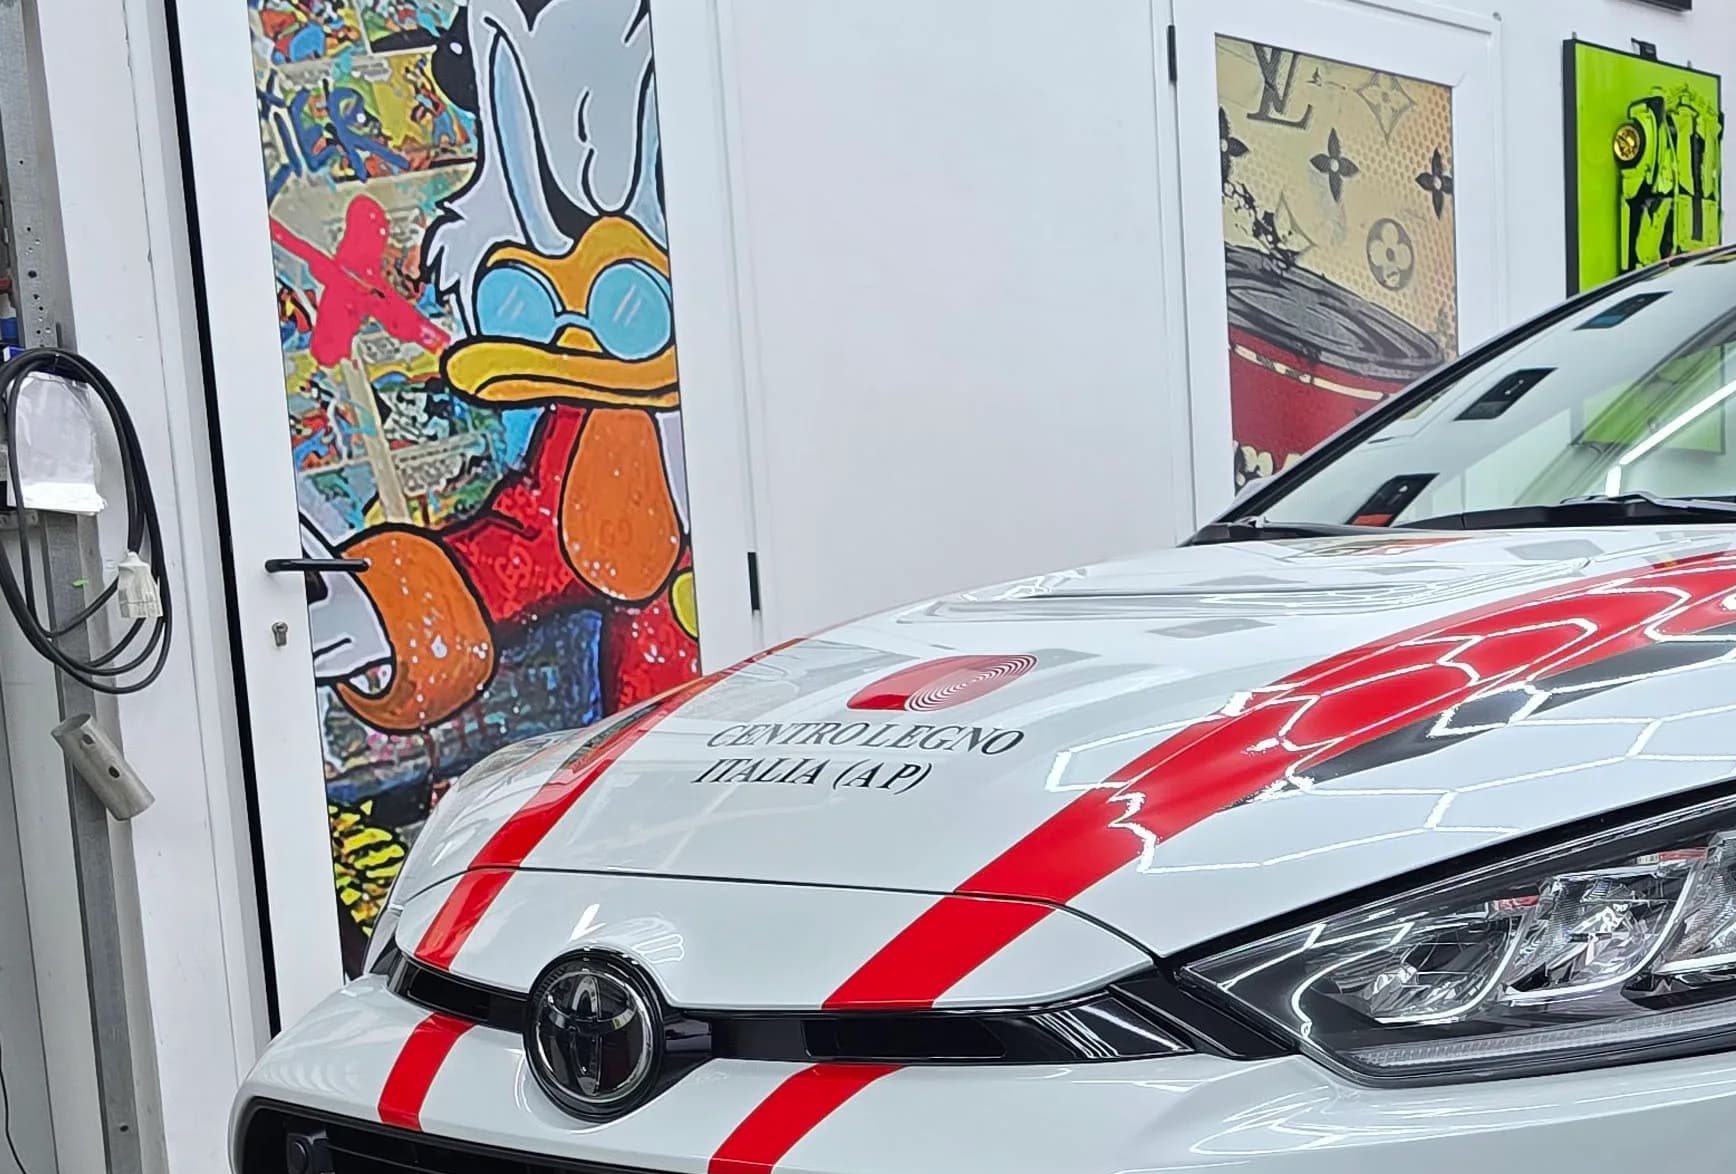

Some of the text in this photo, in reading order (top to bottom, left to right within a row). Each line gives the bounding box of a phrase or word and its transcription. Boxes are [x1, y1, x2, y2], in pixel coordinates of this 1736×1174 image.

[706, 722, 1025, 756] CENTRO LEGNO
[690, 758, 933, 796] ITALIA (AP)
